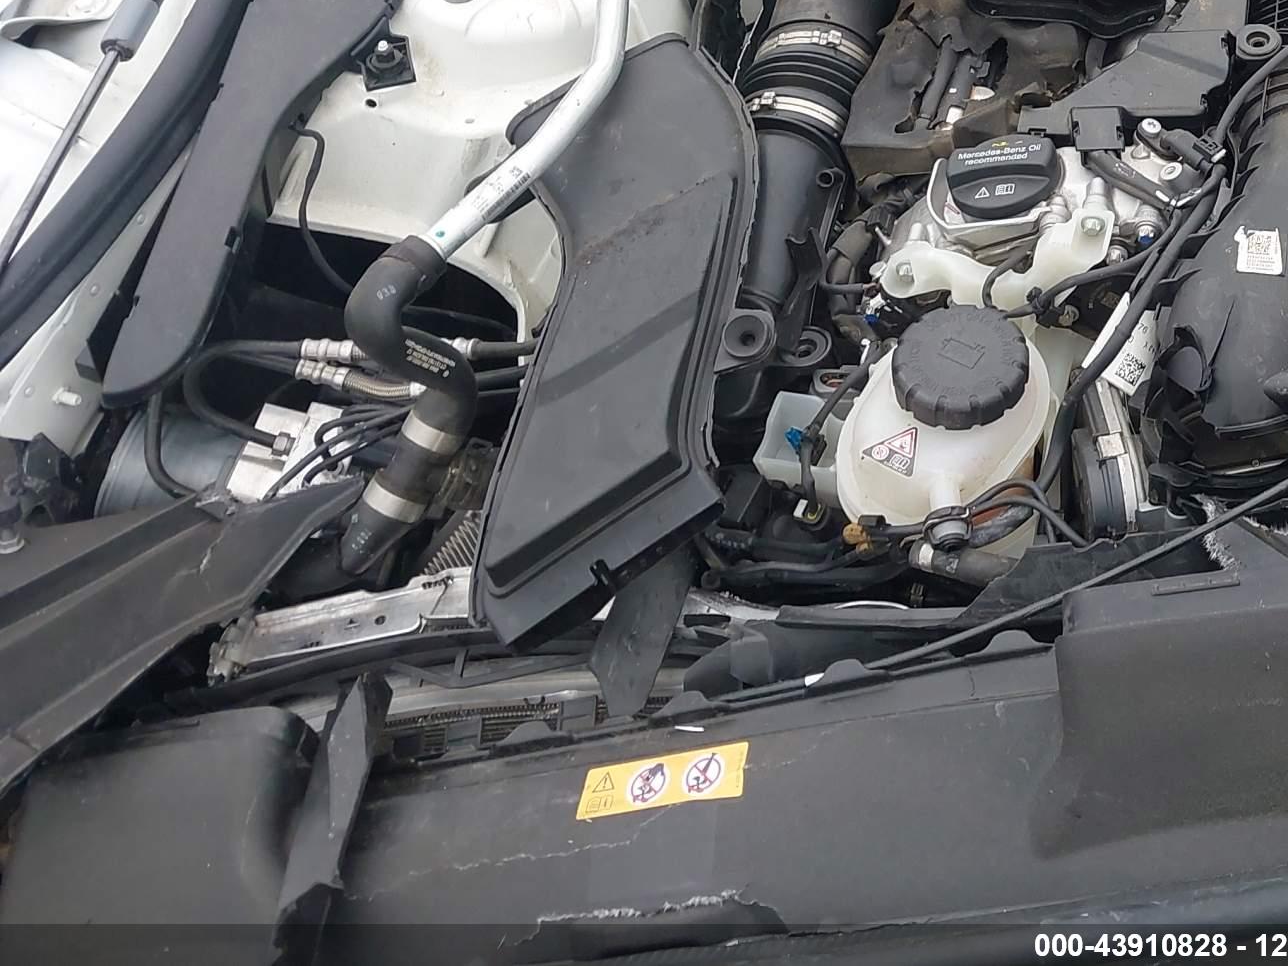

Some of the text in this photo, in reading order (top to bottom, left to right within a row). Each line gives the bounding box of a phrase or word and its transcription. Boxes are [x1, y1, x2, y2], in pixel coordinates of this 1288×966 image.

[958, 143, 1042, 161] Mercedes-Benz Oil
[964, 152, 1028, 166] recommended
